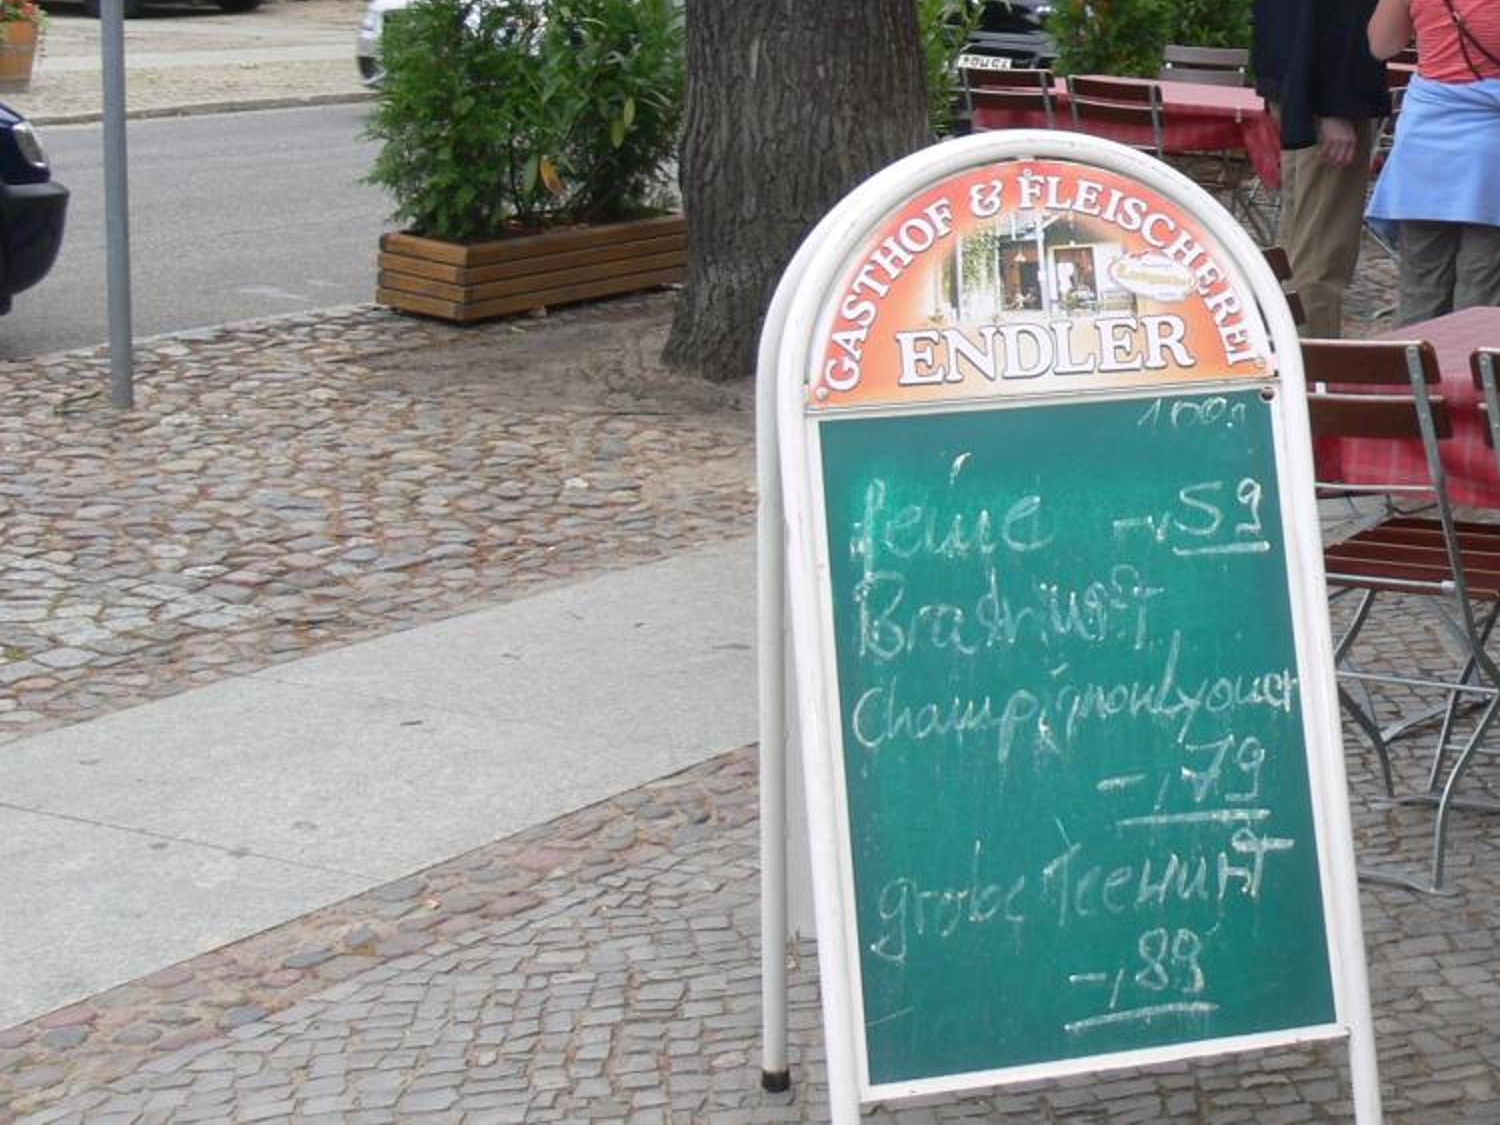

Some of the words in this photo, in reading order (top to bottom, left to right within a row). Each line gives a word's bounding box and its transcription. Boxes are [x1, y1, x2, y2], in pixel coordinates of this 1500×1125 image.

[825, 197, 956, 393] GASTHOF
[968, 179, 1004, 218] &
[1018, 173, 1266, 365] FLEISCHEREI
[895, 312, 1196, 386] ENDLER
